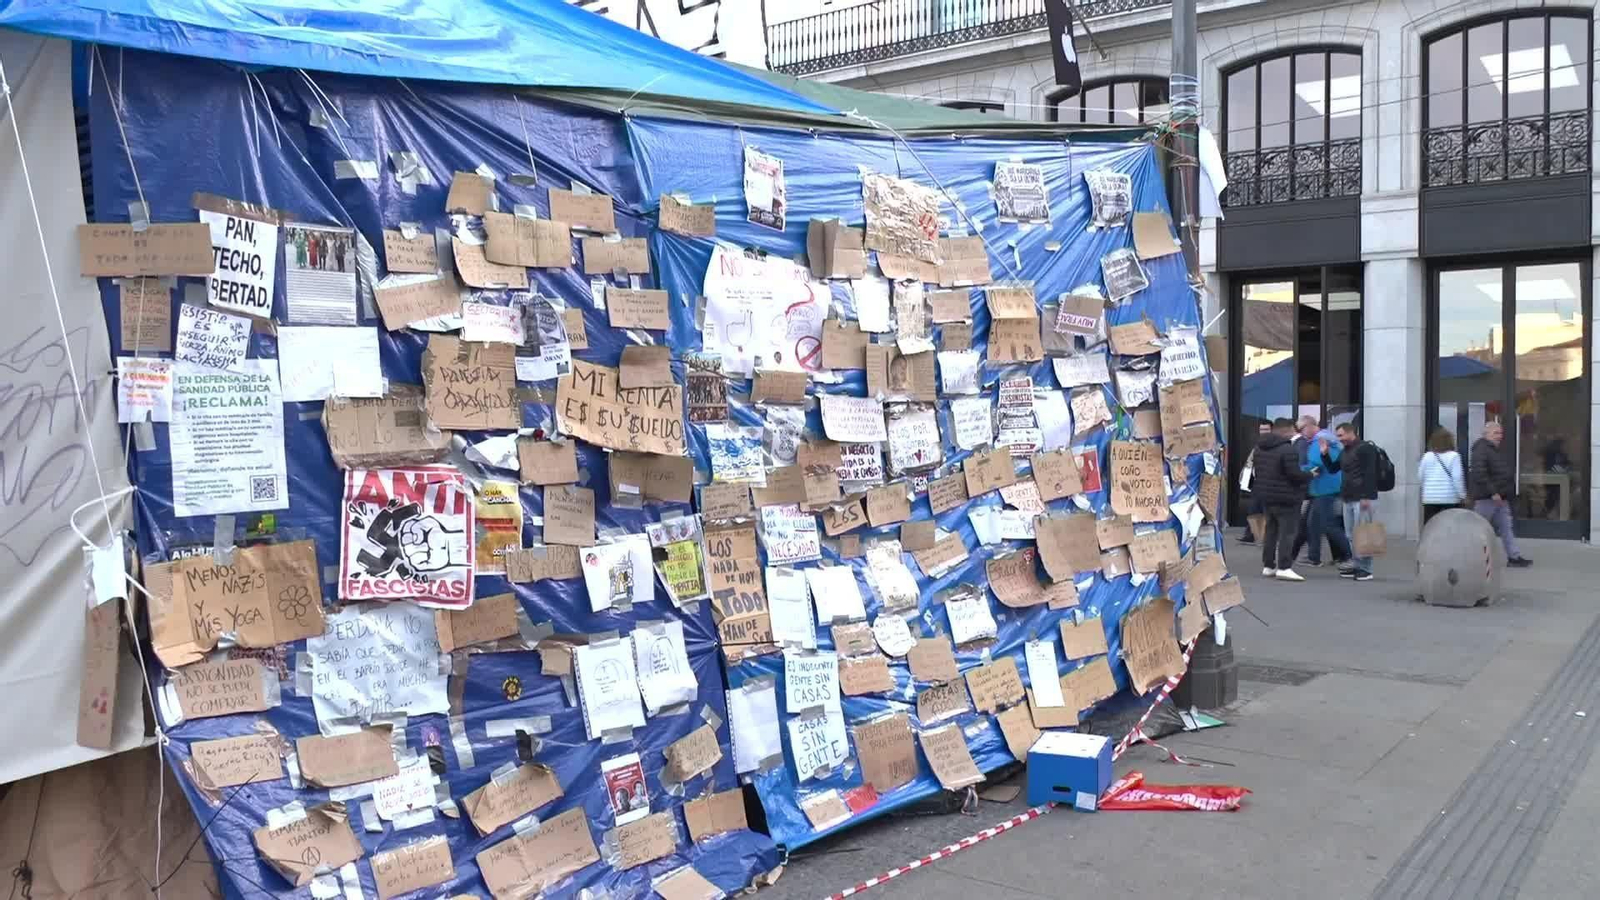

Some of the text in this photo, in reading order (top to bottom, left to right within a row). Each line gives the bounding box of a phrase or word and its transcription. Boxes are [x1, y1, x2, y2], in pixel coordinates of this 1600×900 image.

[225, 217, 257, 247] PAN,
[213, 247, 263, 280] TECHO,
[178, 374, 272, 384] EN DEFENSA DE LA
[179, 383, 270, 394] SANIDAD PÚBLICA
[572, 364, 606, 397] MI
[183, 395, 268, 411] ¡RECLAMA!
[1120, 466, 1141, 476] COÑO
[353, 471, 466, 514] ANTI
[1129, 479, 1151, 489] VOTO
[708, 537, 732, 558] LOS
[713, 560, 739, 574] NADA
[186, 565, 236, 592] MENOS
[739, 571, 755, 585] HOY
[348, 579, 465, 598] FASCISTAS
[194, 600, 204, 616] Y
[194, 605, 264, 640] MÁS YOGA
[404, 613, 421, 634] NO
[723, 619, 757, 642] HAN DE
[355, 647, 376, 659] QUE
[196, 665, 254, 684] DIGNIDAD
[790, 673, 812, 686] GENTE
[186, 684, 202, 699] NO
[208, 683, 219, 694] SE
[794, 684, 831, 704] CASAS
[798, 715, 828, 734] CASAS
[799, 741, 841, 775] GENTE
